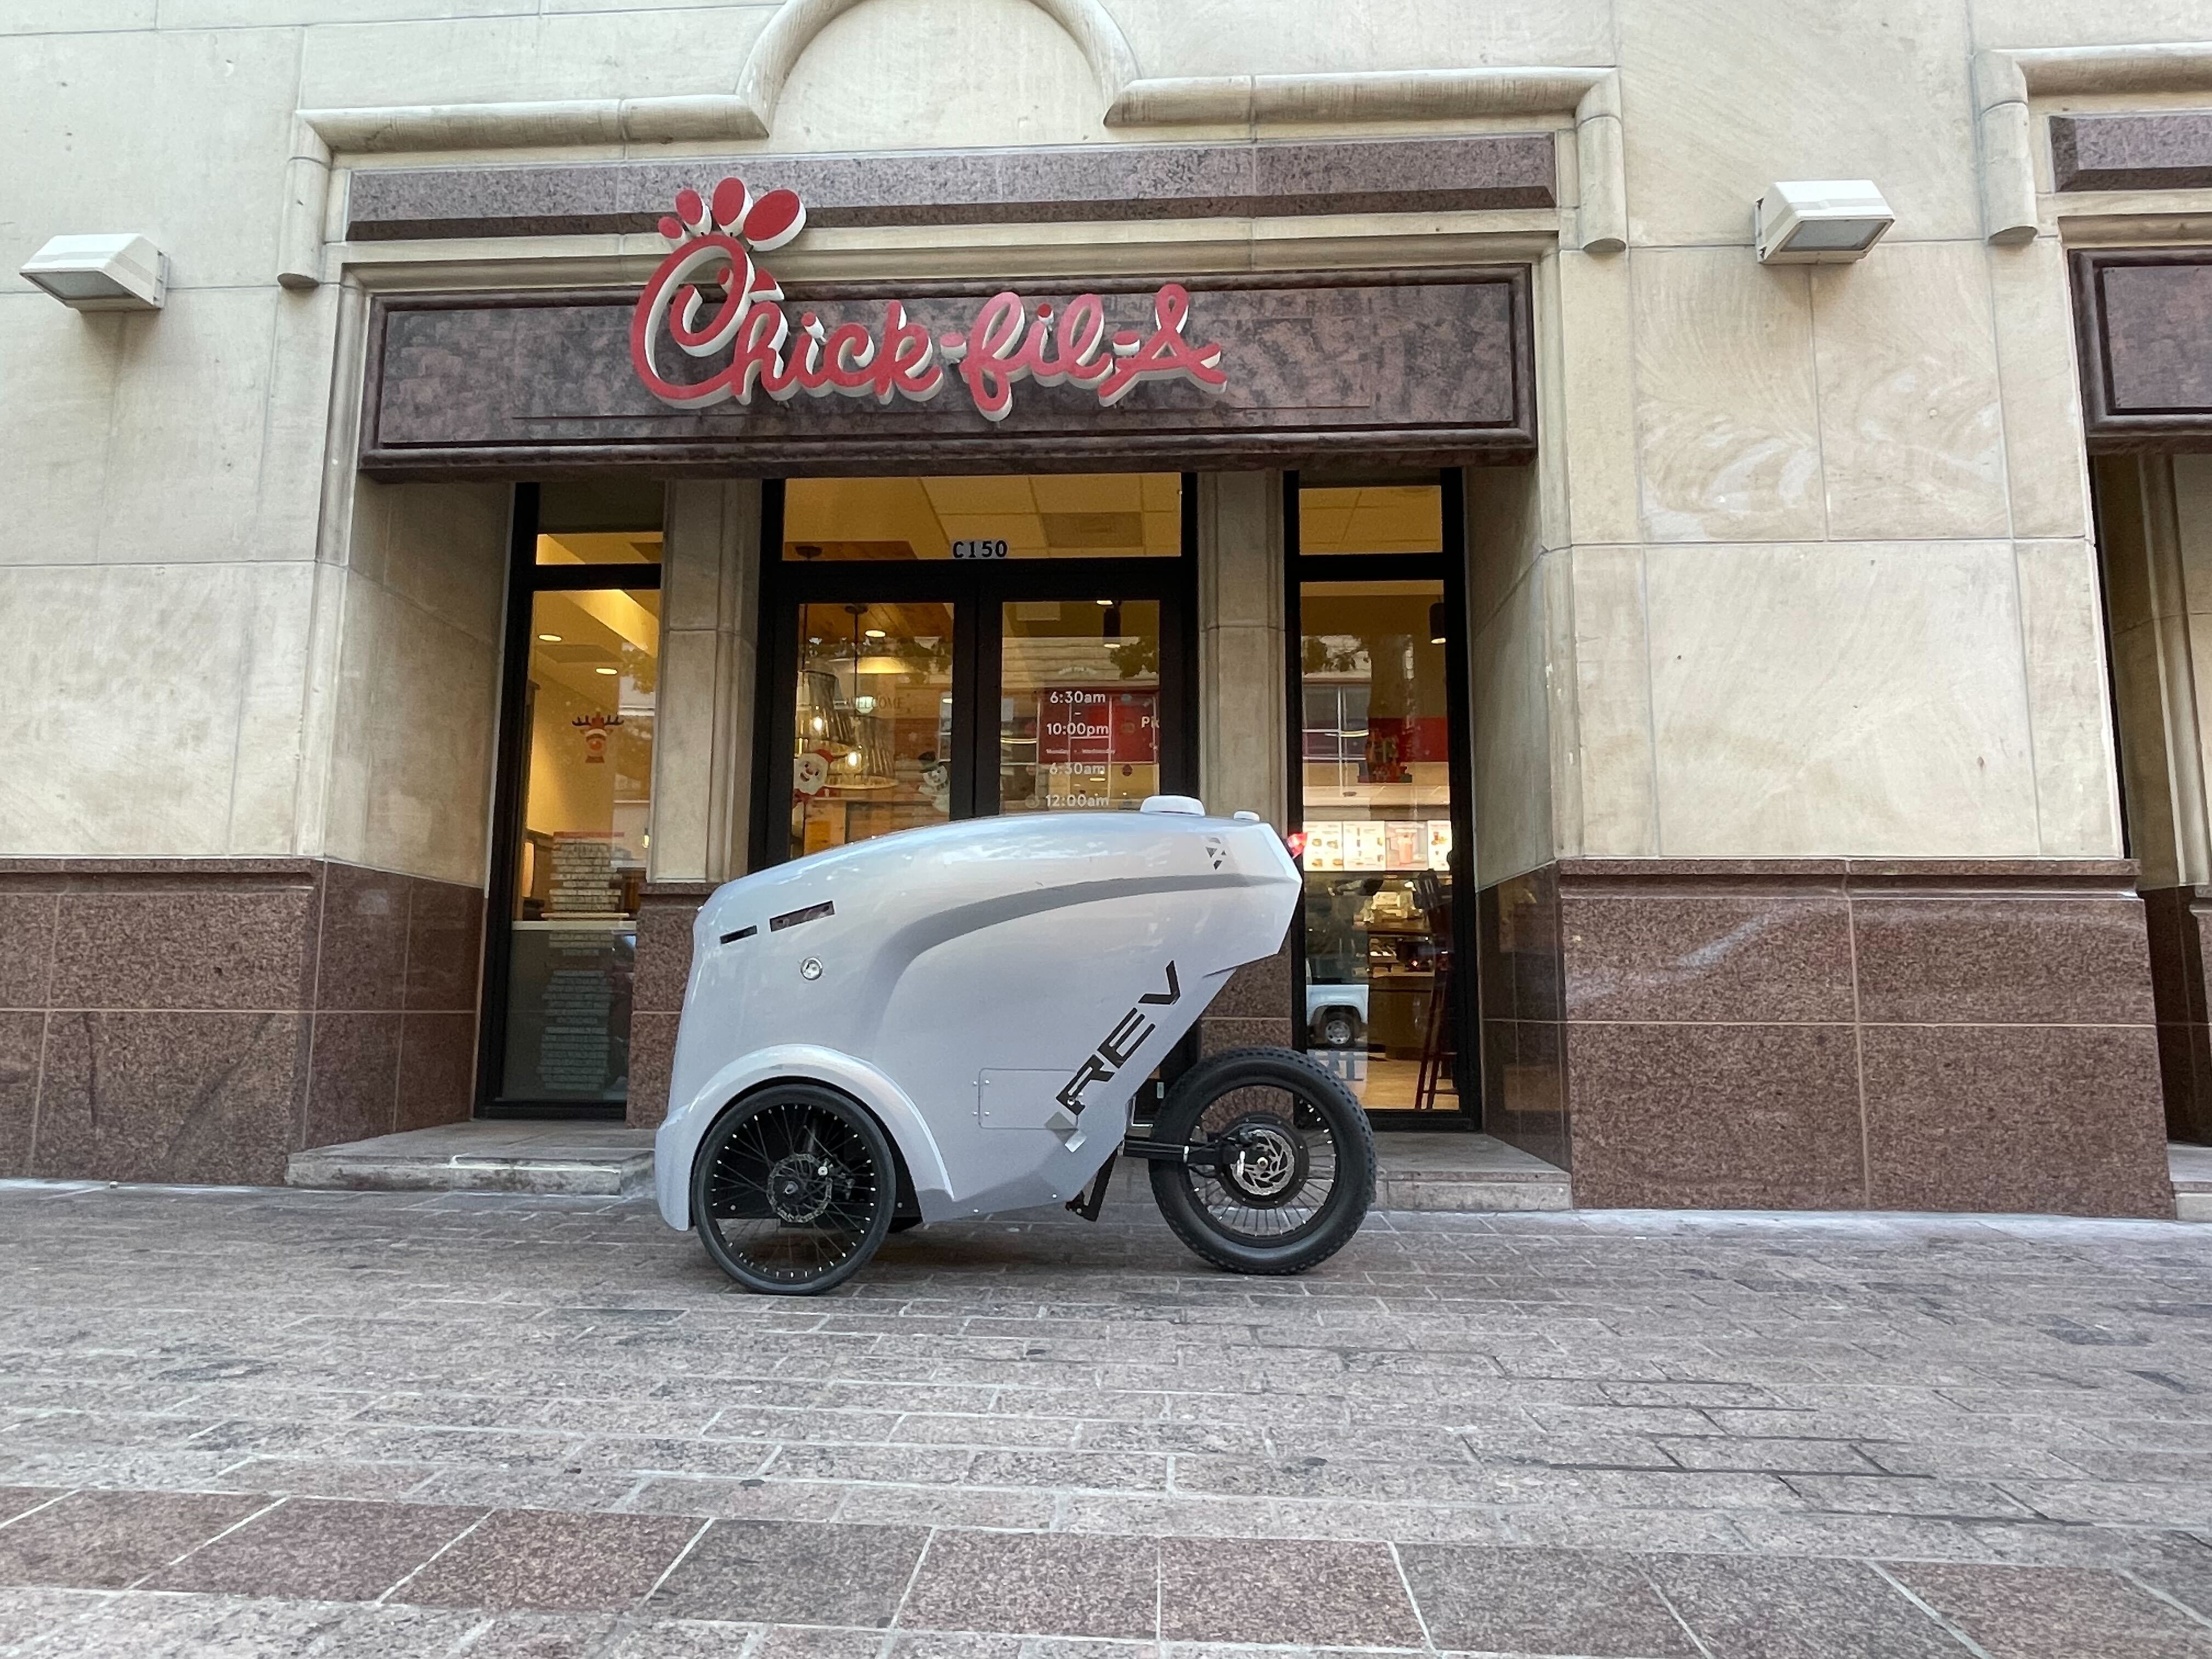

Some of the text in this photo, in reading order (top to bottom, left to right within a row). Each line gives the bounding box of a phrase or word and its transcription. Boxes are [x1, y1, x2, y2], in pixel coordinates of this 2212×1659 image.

[631, 233, 1228, 421] Chick-fil-A
[952, 540, 1008, 558] C150
[1050, 691, 1106, 703] 6:30am
[1047, 723, 1109, 736] 10:00pm
[1049, 763, 1106, 775] 6:30am
[1046, 794, 1109, 807] 12:00am
[1056, 960, 1181, 1115] REV
